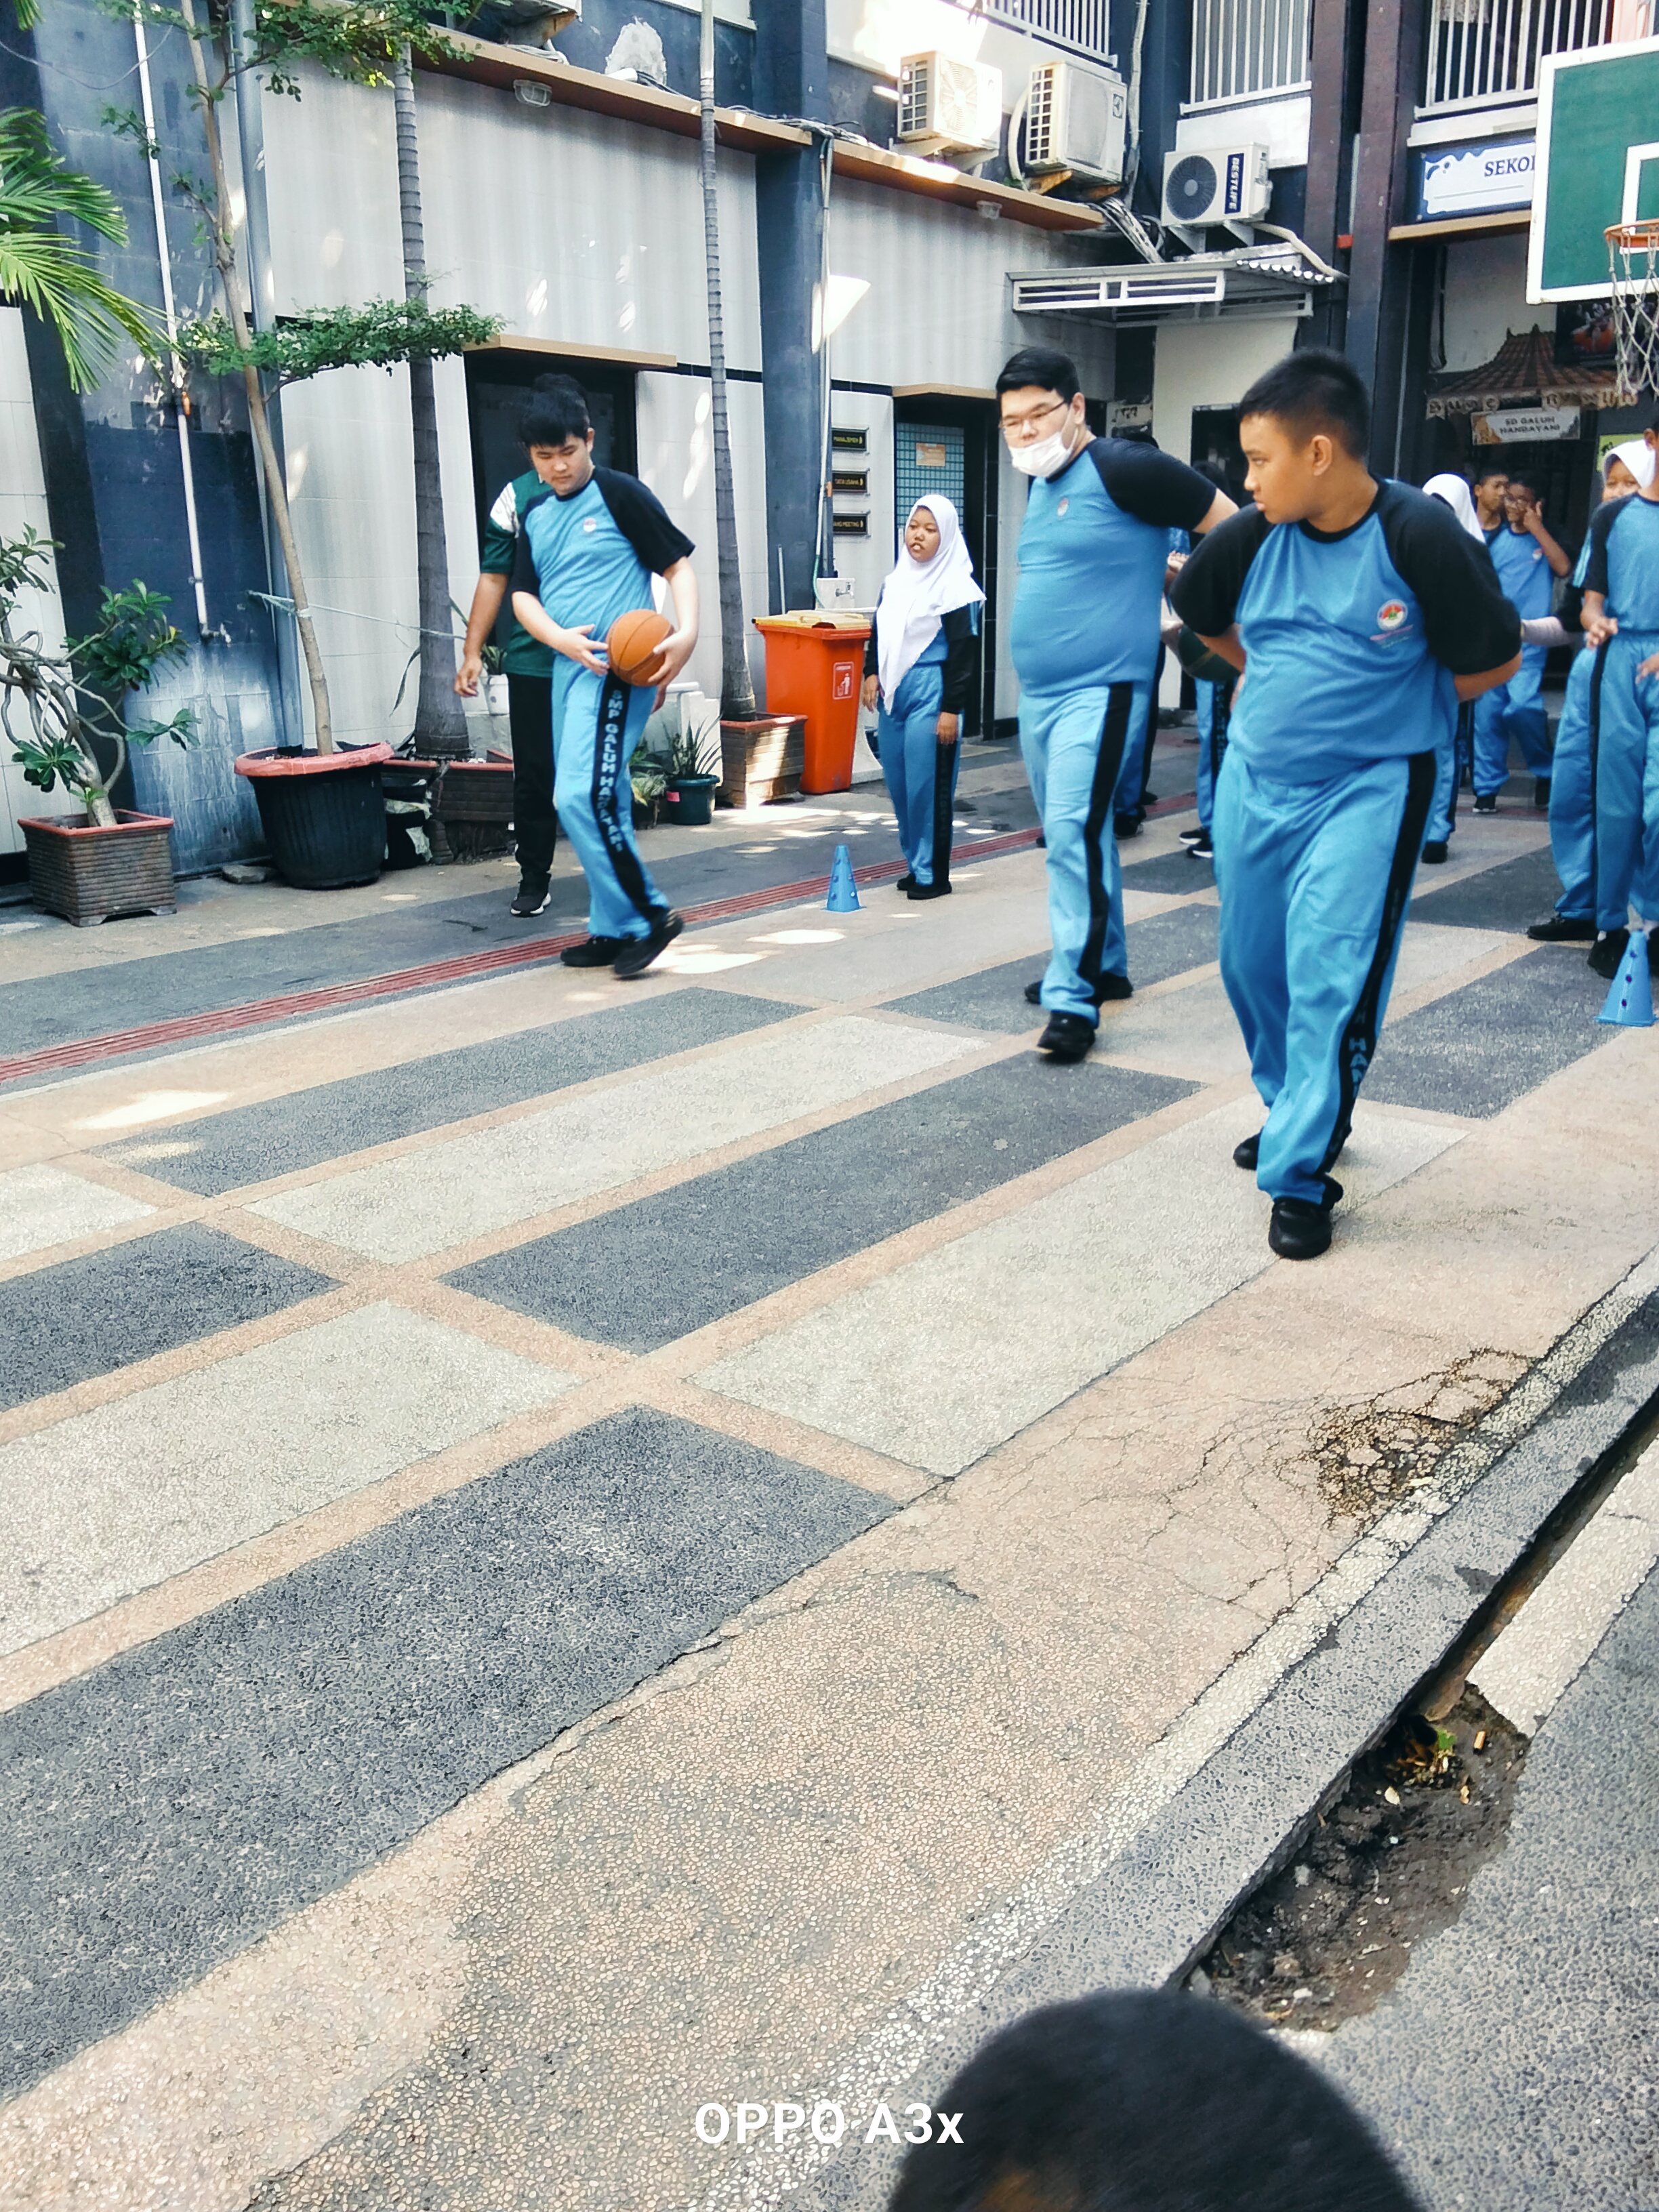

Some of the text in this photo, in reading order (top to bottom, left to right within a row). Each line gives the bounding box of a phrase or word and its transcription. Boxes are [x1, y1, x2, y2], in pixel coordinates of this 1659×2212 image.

[1229, 157, 1240, 210] BESTLIFE
[607, 689, 623, 719] SMP
[601, 723, 619, 773] GALUH
